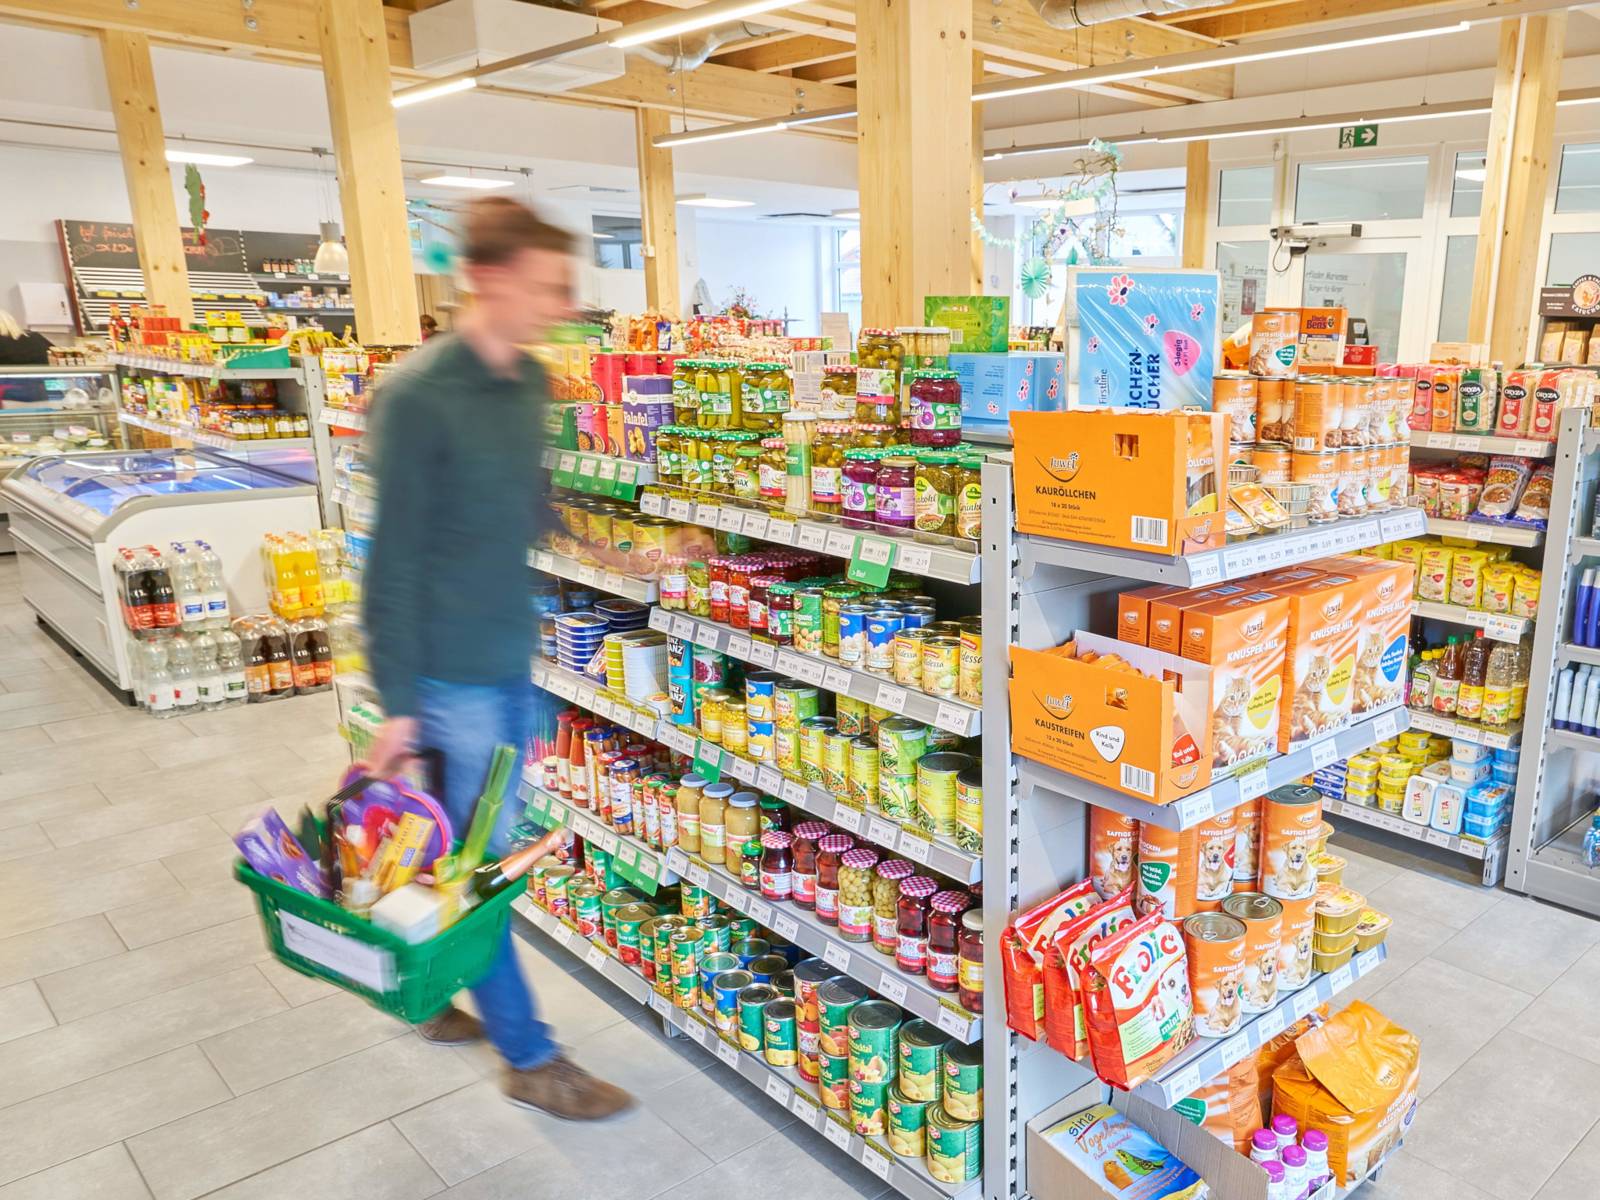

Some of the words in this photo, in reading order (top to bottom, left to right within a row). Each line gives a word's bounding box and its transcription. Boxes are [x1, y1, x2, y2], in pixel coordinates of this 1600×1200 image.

[624, 411, 648, 427] Falafel
[1035, 485, 1096, 500] KAURÖLLCHEN
[668, 643, 685, 654] ANZ
[671, 691, 684, 706] ANZ
[1035, 718, 1085, 740] KAUSTREIFEN
[1112, 931, 1179, 1000] Frolic
[1068, 1112, 1095, 1137] sina
